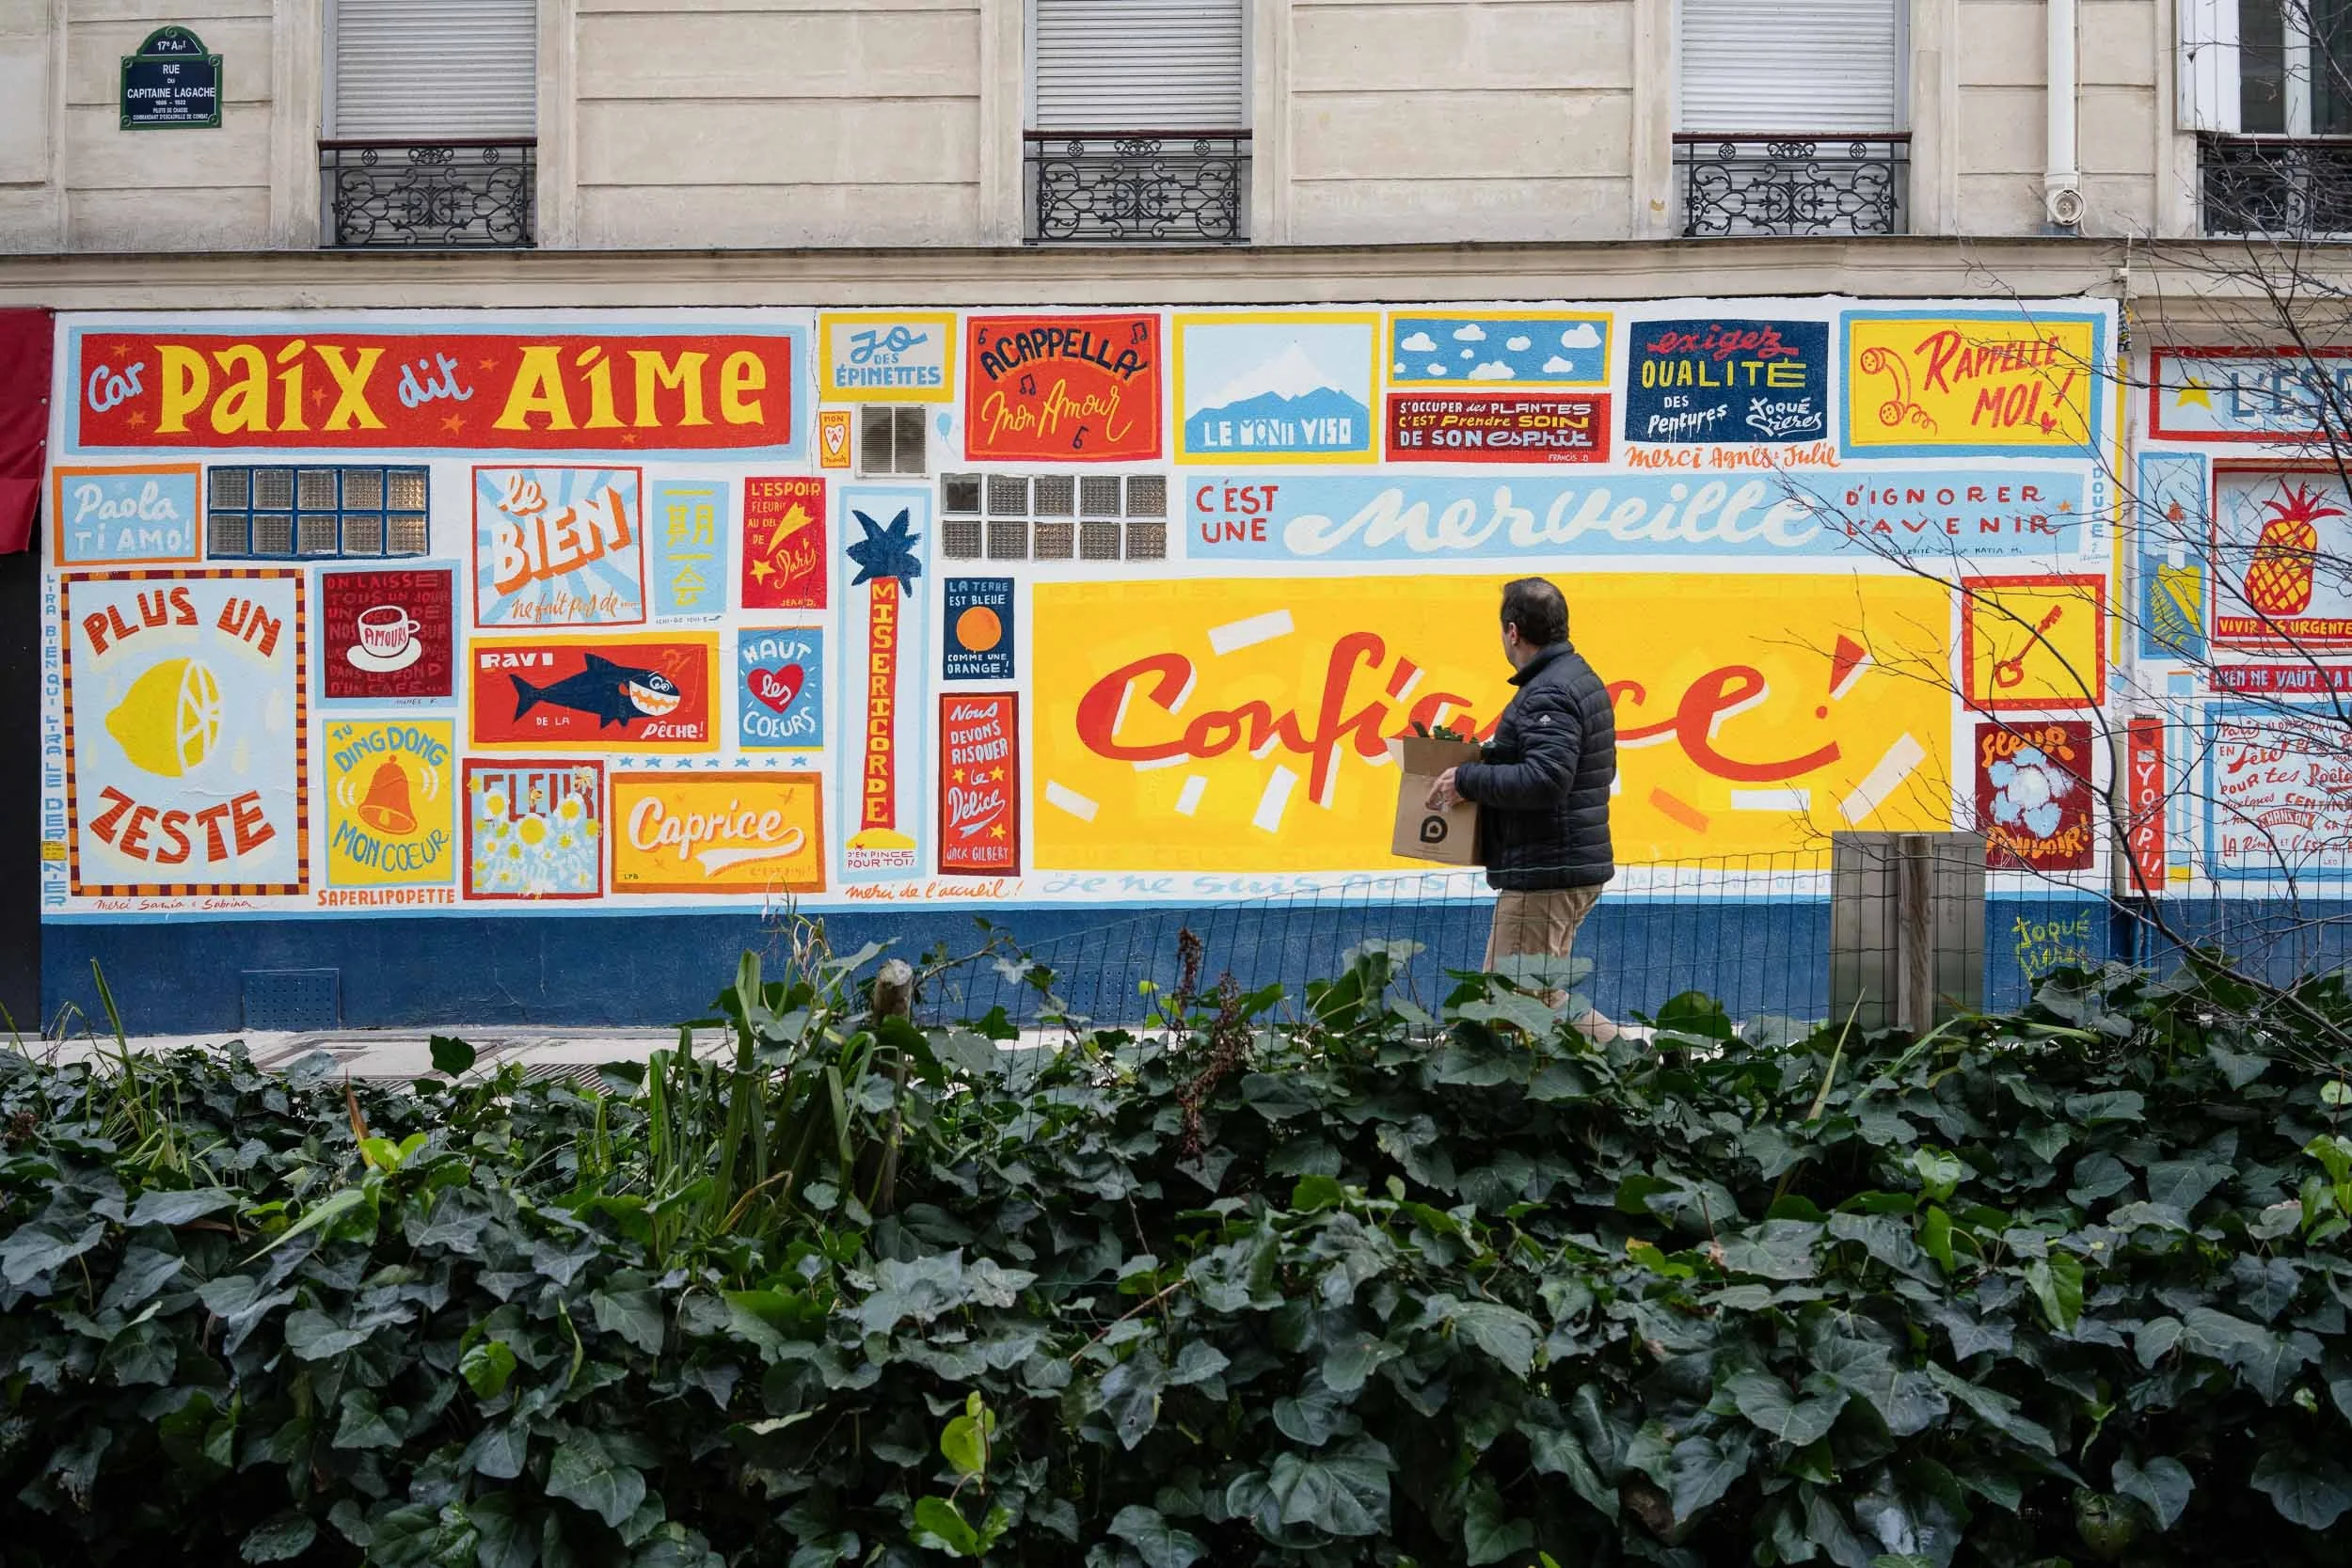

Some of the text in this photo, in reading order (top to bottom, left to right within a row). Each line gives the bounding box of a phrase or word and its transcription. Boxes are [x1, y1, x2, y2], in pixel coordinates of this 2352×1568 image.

[163, 64, 180, 74] RUE
[127, 87, 215, 99] CAPITAINE LAGACHE
[874, 354, 899, 364] DES
[88, 361, 144, 413] Car
[398, 352, 473, 408] dit
[835, 364, 942, 387] ÉPINETTES
[1400, 402, 1592, 415] S'OCCUPER des PLANTES
[1663, 395, 1690, 409] DES
[1399, 415, 1437, 428] C'EST
[1518, 415, 1589, 429] SOIN
[1204, 421, 1232, 447] LE
[1301, 418, 1352, 445] VISO
[1400, 430, 1423, 447] DE
[1432, 429, 1483, 448] SON
[752, 482, 821, 497] L'ESPOIR
[1846, 484, 2046, 506] D'IGNORER
[74, 481, 179, 525] Paola
[747, 519, 759, 528] AU
[1201, 517, 1267, 543] UNE
[490, 483, 631, 595] BIEN
[753, 534, 765, 545] DE
[327, 573, 438, 588] ON LAISSE
[948, 581, 1009, 592] LA TERRE
[600, 587, 618, 617] de
[949, 594, 1006, 606] EST BLEUE
[83, 586, 282, 657] PLUS UN
[329, 624, 357, 640] NOS
[364, 627, 406, 647] AMOURS
[742, 640, 812, 664] HAUT
[947, 650, 983, 661] COMME
[760, 673, 792, 705] les
[866, 583, 896, 822] MISERICORDE
[949, 702, 999, 721] Nous
[536, 717, 570, 726] DE LA
[332, 724, 353, 741] TU
[950, 720, 1001, 745] DEVONS
[951, 737, 1009, 765] RISQUER
[947, 786, 1006, 829] Délice
[89, 785, 277, 863] ZESTE
[628, 797, 805, 861] Caprice
[332, 819, 381, 867] MON
[870, 850, 914, 859] PINCE
[971, 846, 1009, 862] GILBERT
[847, 860, 882, 868] POUR
[317, 888, 455, 907] SAPERLIPOPETTE
[898, 882, 920, 899] de
